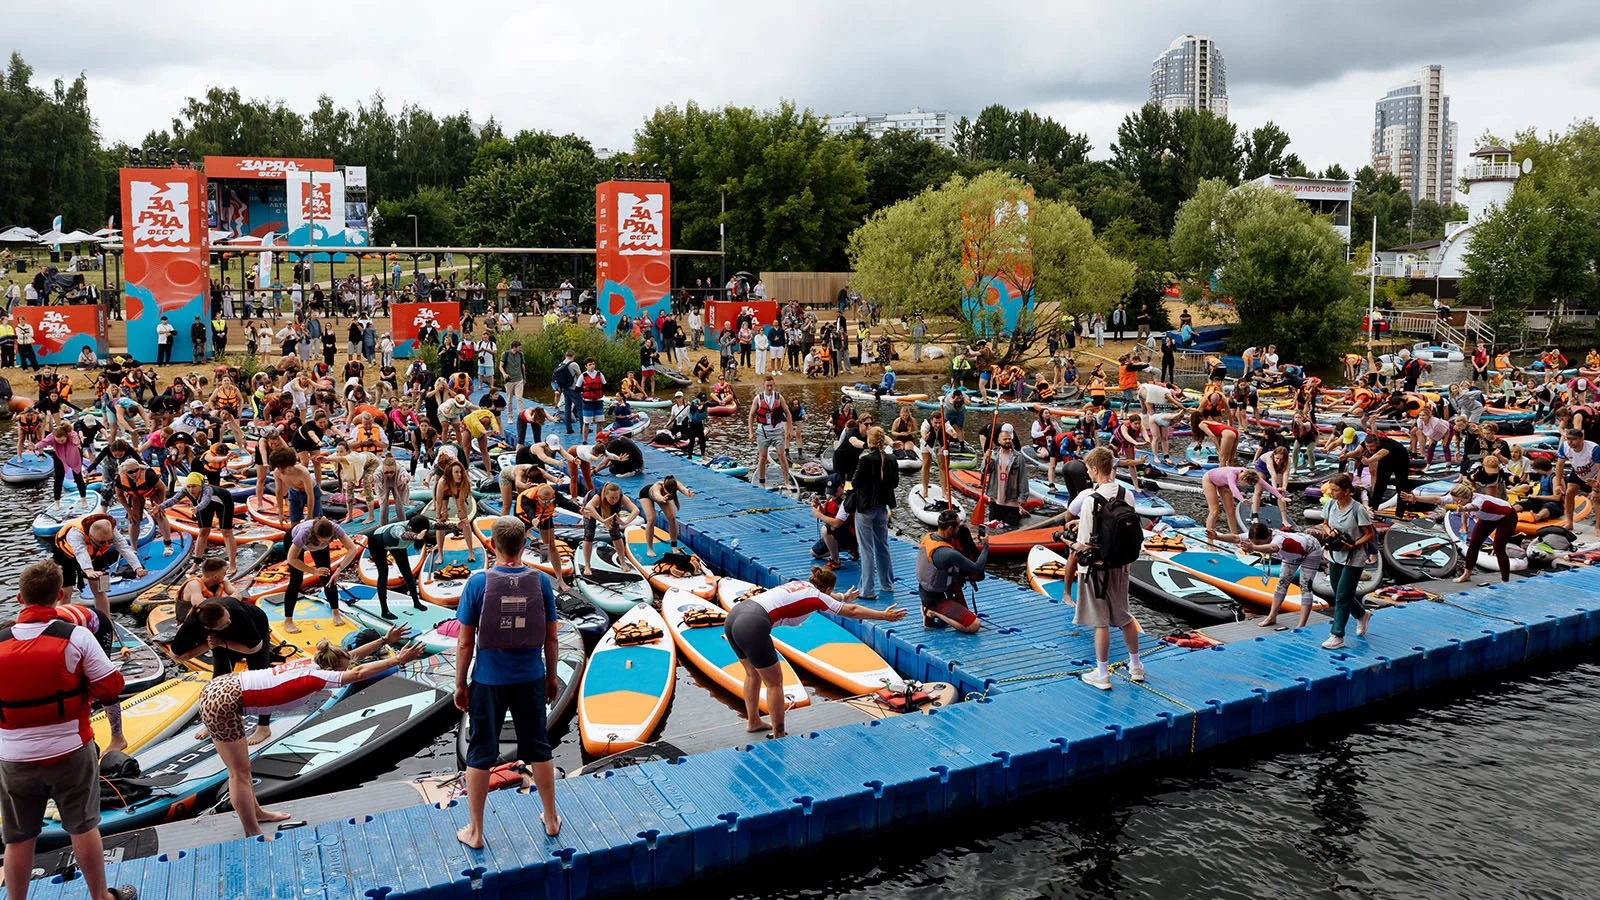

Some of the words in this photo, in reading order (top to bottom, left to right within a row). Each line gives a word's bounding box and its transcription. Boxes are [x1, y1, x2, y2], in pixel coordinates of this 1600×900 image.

[147, 196, 175, 212] ЗА
[138, 211, 183, 229] РЯД
[630, 206, 652, 220] ЗА
[623, 219, 658, 235] РЯД
[38, 321, 72, 333] РЯД
